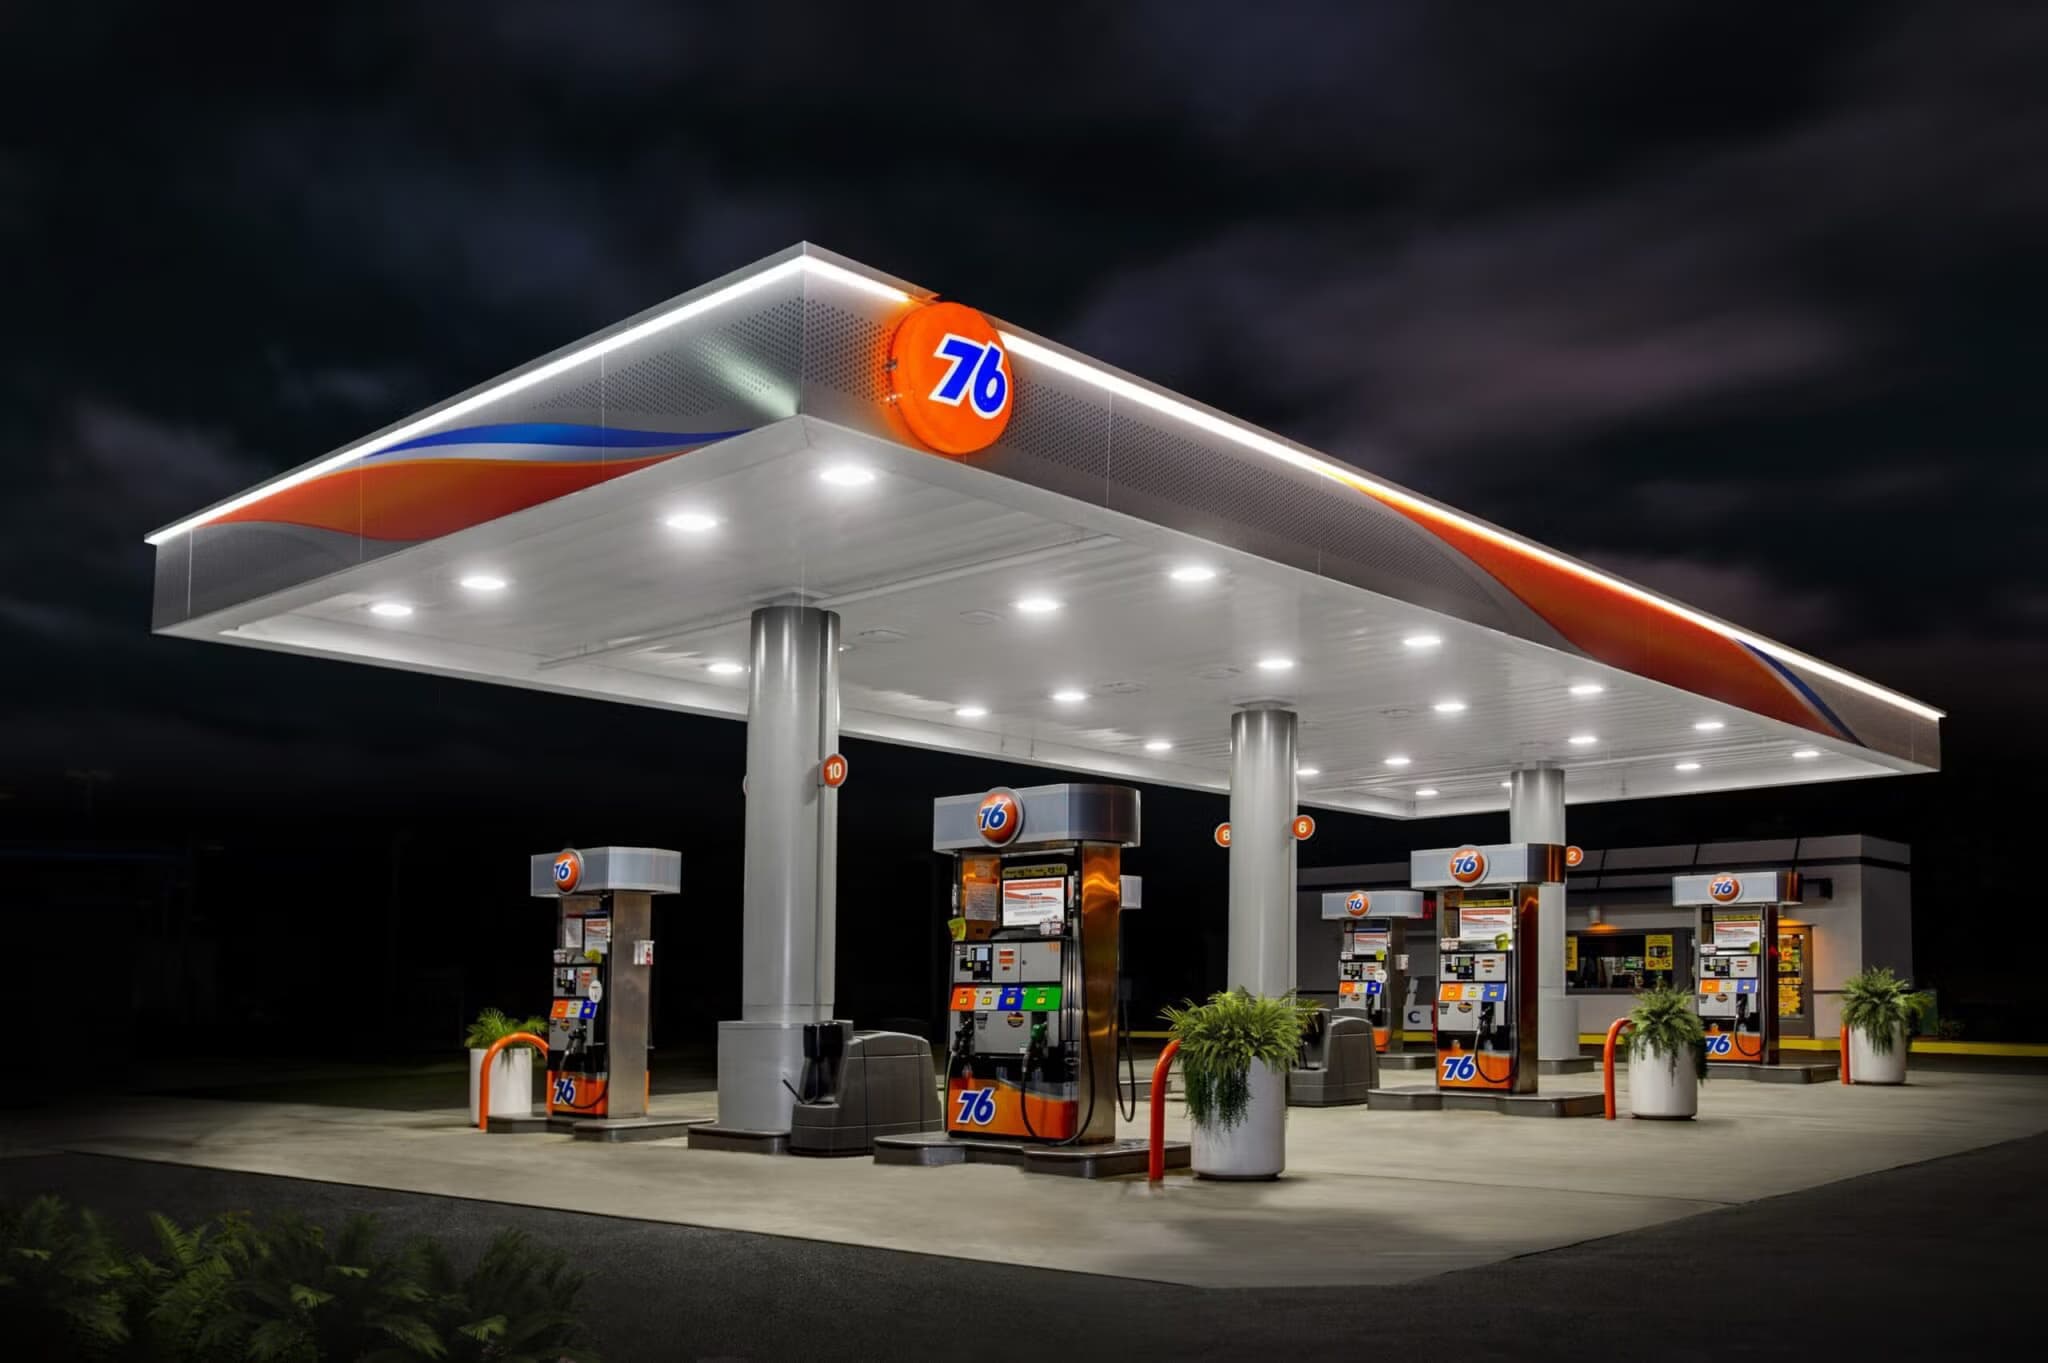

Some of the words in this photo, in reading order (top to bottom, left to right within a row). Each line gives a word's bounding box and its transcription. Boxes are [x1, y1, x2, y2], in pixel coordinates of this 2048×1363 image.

[928, 333, 1008, 420] 76
[827, 762, 842, 780] 10
[979, 801, 1008, 832] 76
[1298, 821, 1307, 834] 6
[1453, 855, 1478, 875] 76
[1568, 851, 1577, 861] 2
[1712, 880, 1734, 897] 76
[1705, 1033, 1733, 1054] 76
[1442, 1054, 1478, 1081] 76
[553, 1076, 577, 1105] 76
[956, 1087, 996, 1126] 76
